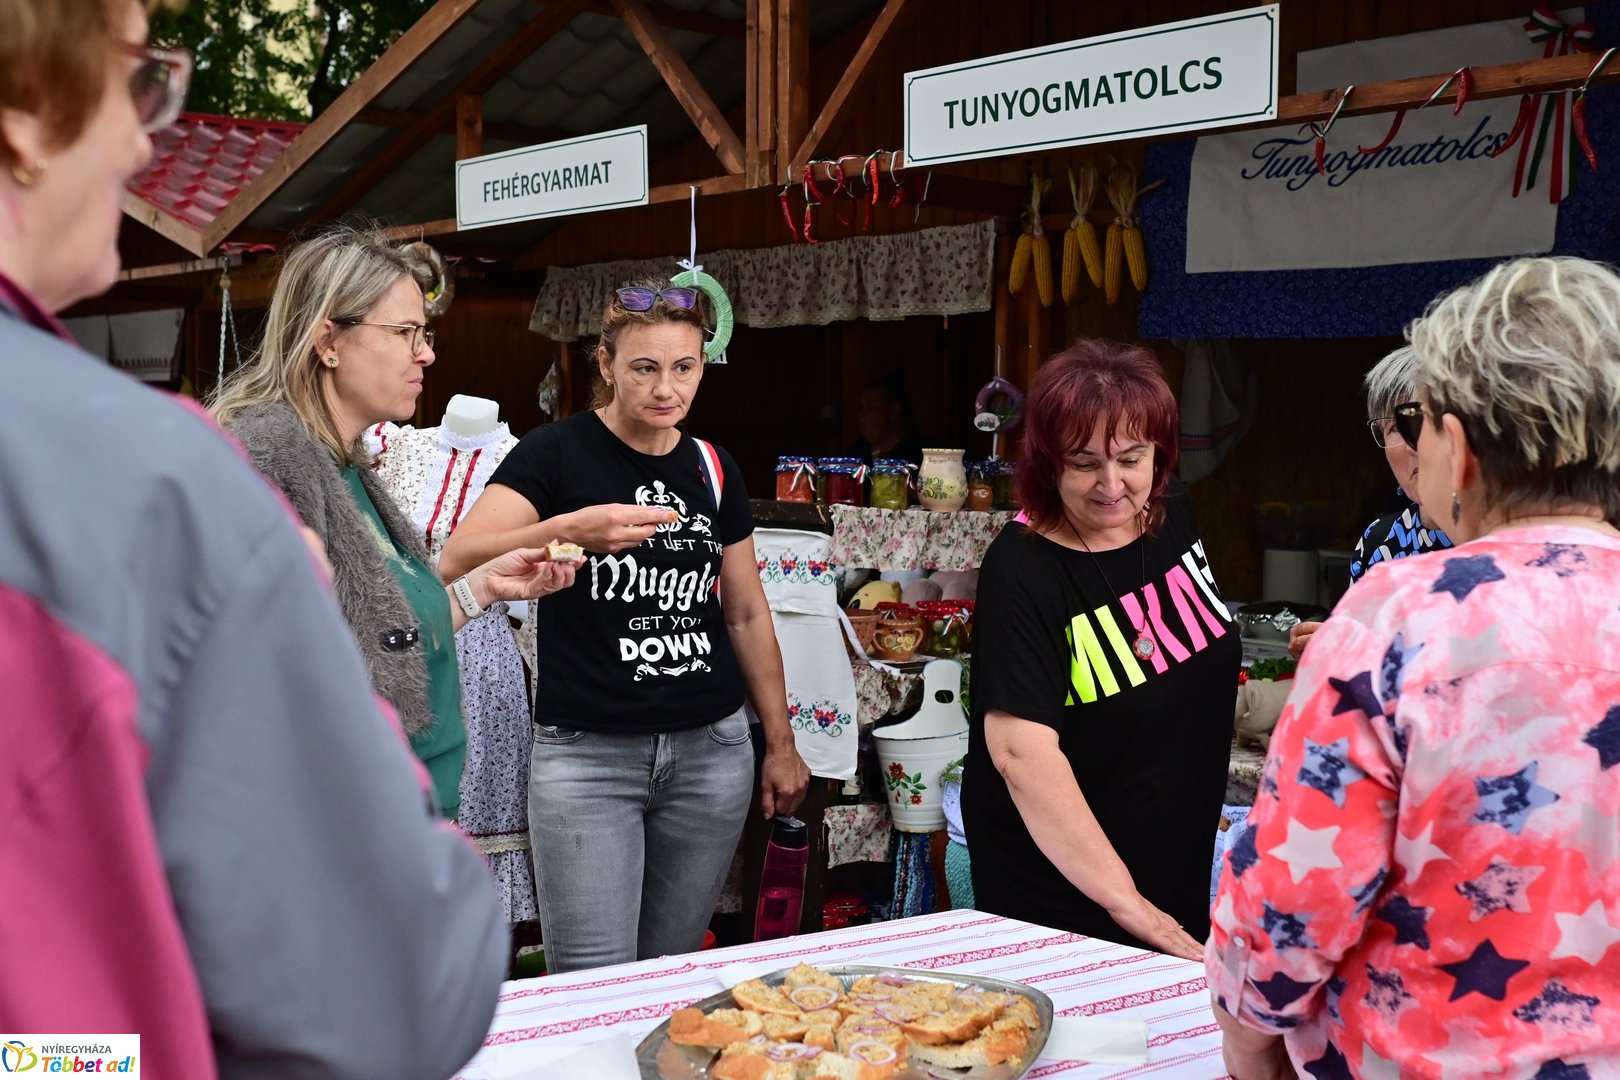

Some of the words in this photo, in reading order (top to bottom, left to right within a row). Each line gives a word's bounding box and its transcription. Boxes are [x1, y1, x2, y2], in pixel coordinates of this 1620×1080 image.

[944, 56, 1223, 129] TUNYOGMATOLCS
[1241, 116, 1509, 192] Tunyogmatolcs
[483, 160, 612, 203] FEHÉRGYARMAT
[662, 538, 696, 551] LET
[628, 615, 664, 631] GET
[618, 631, 712, 662] DOWN
